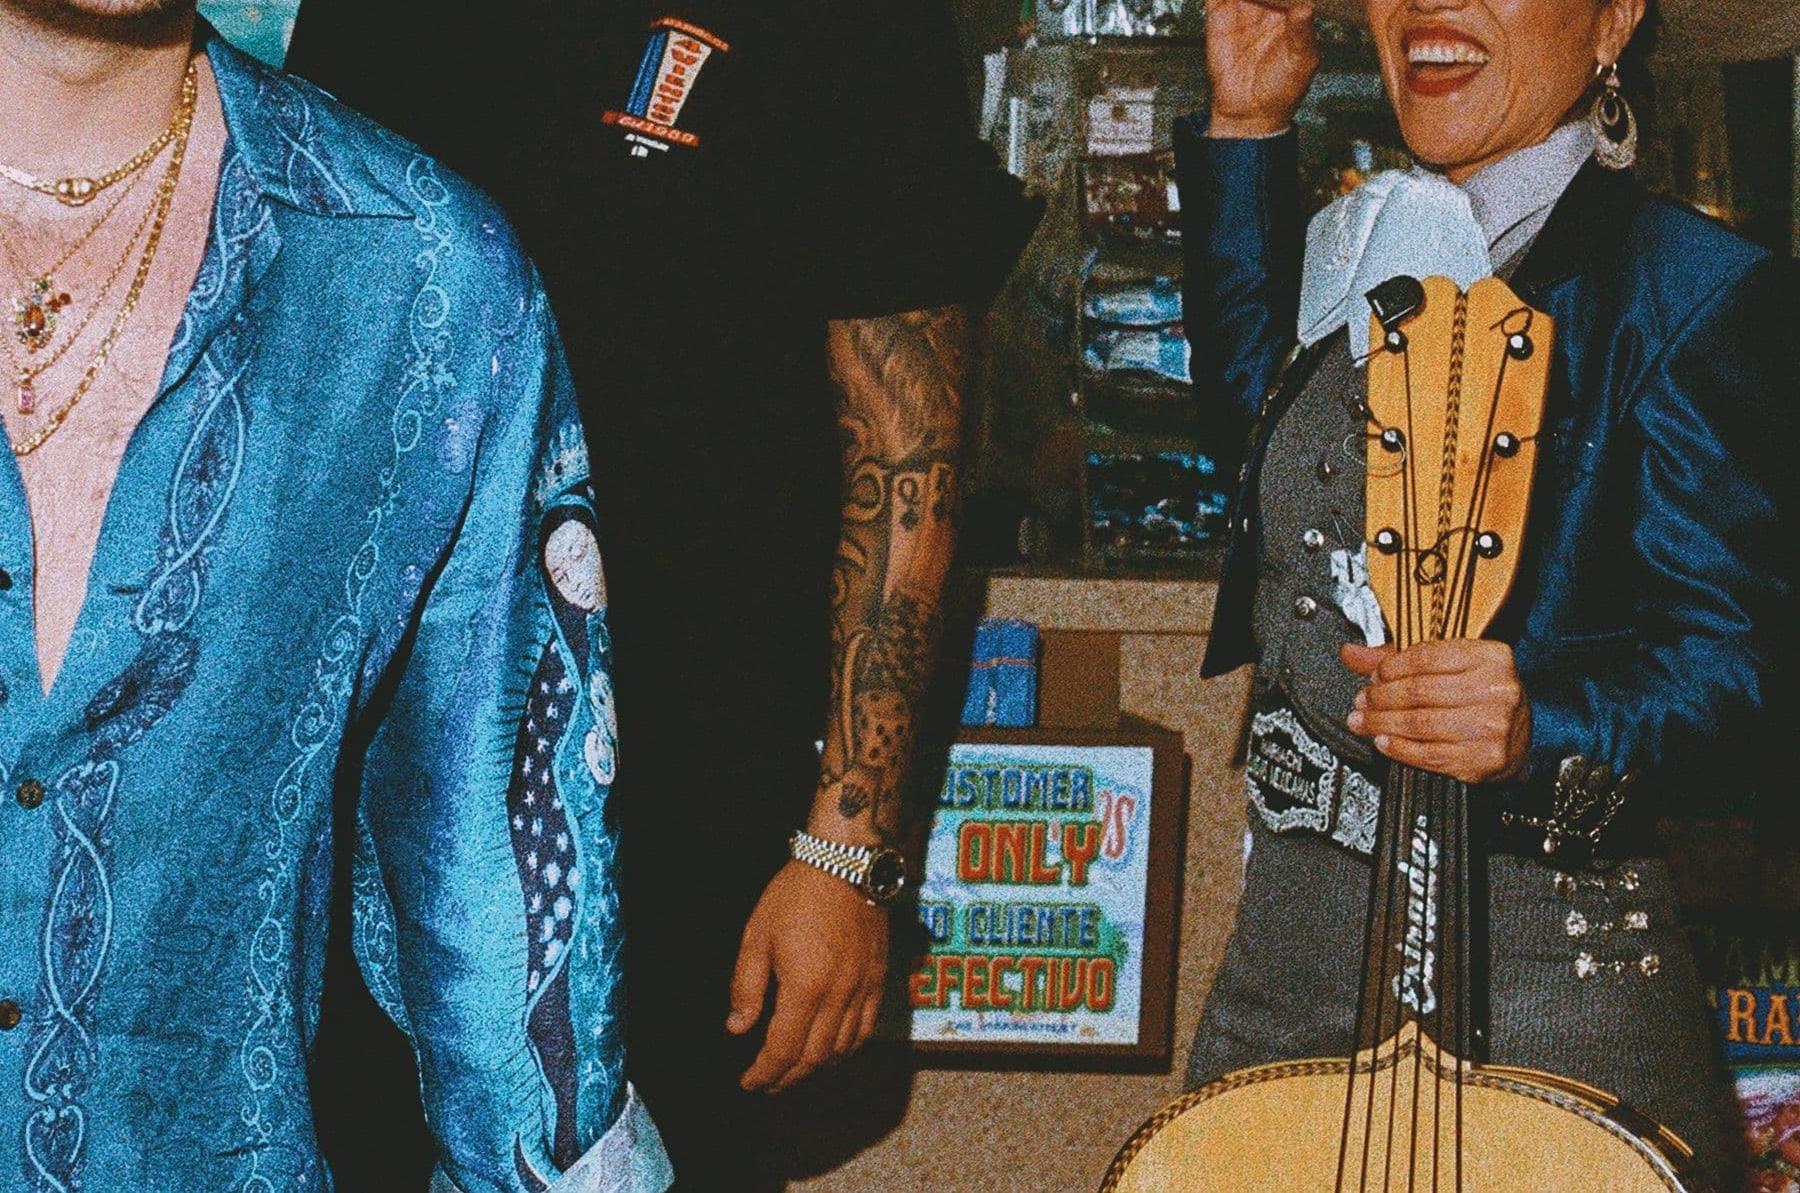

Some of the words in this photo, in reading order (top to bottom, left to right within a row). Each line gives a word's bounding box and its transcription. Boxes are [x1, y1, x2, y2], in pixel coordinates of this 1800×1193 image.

[958, 822, 1099, 885] ONLY
[969, 905, 1099, 945] CLIENTE
[908, 956, 1114, 1009] EFECTIVO
[1726, 988, 1800, 1046] RA
